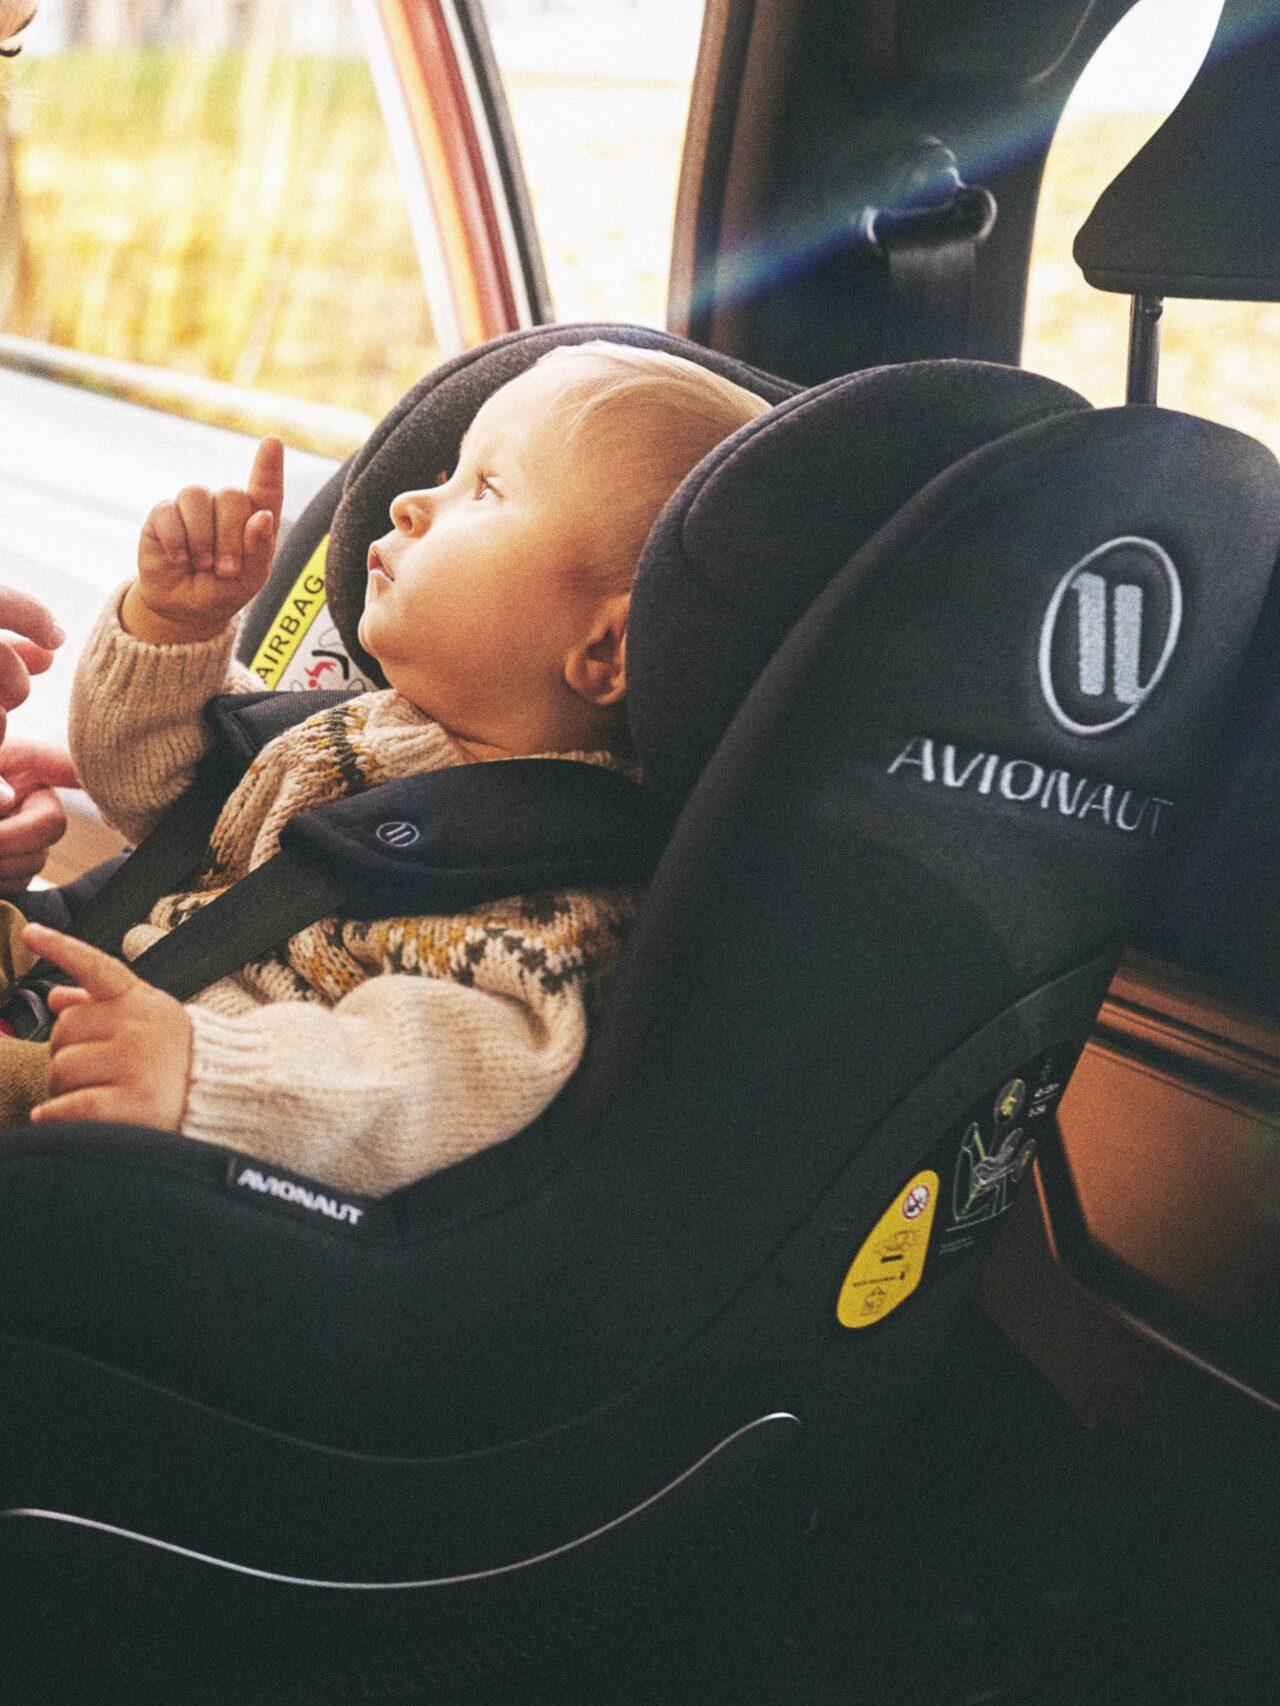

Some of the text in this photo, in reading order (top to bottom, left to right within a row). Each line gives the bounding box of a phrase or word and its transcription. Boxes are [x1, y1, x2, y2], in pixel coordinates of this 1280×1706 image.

[255, 574, 324, 684] AIRBAG
[887, 737, 1173, 836] AVIONAUT
[237, 1168, 363, 1225] AVIONAUT
